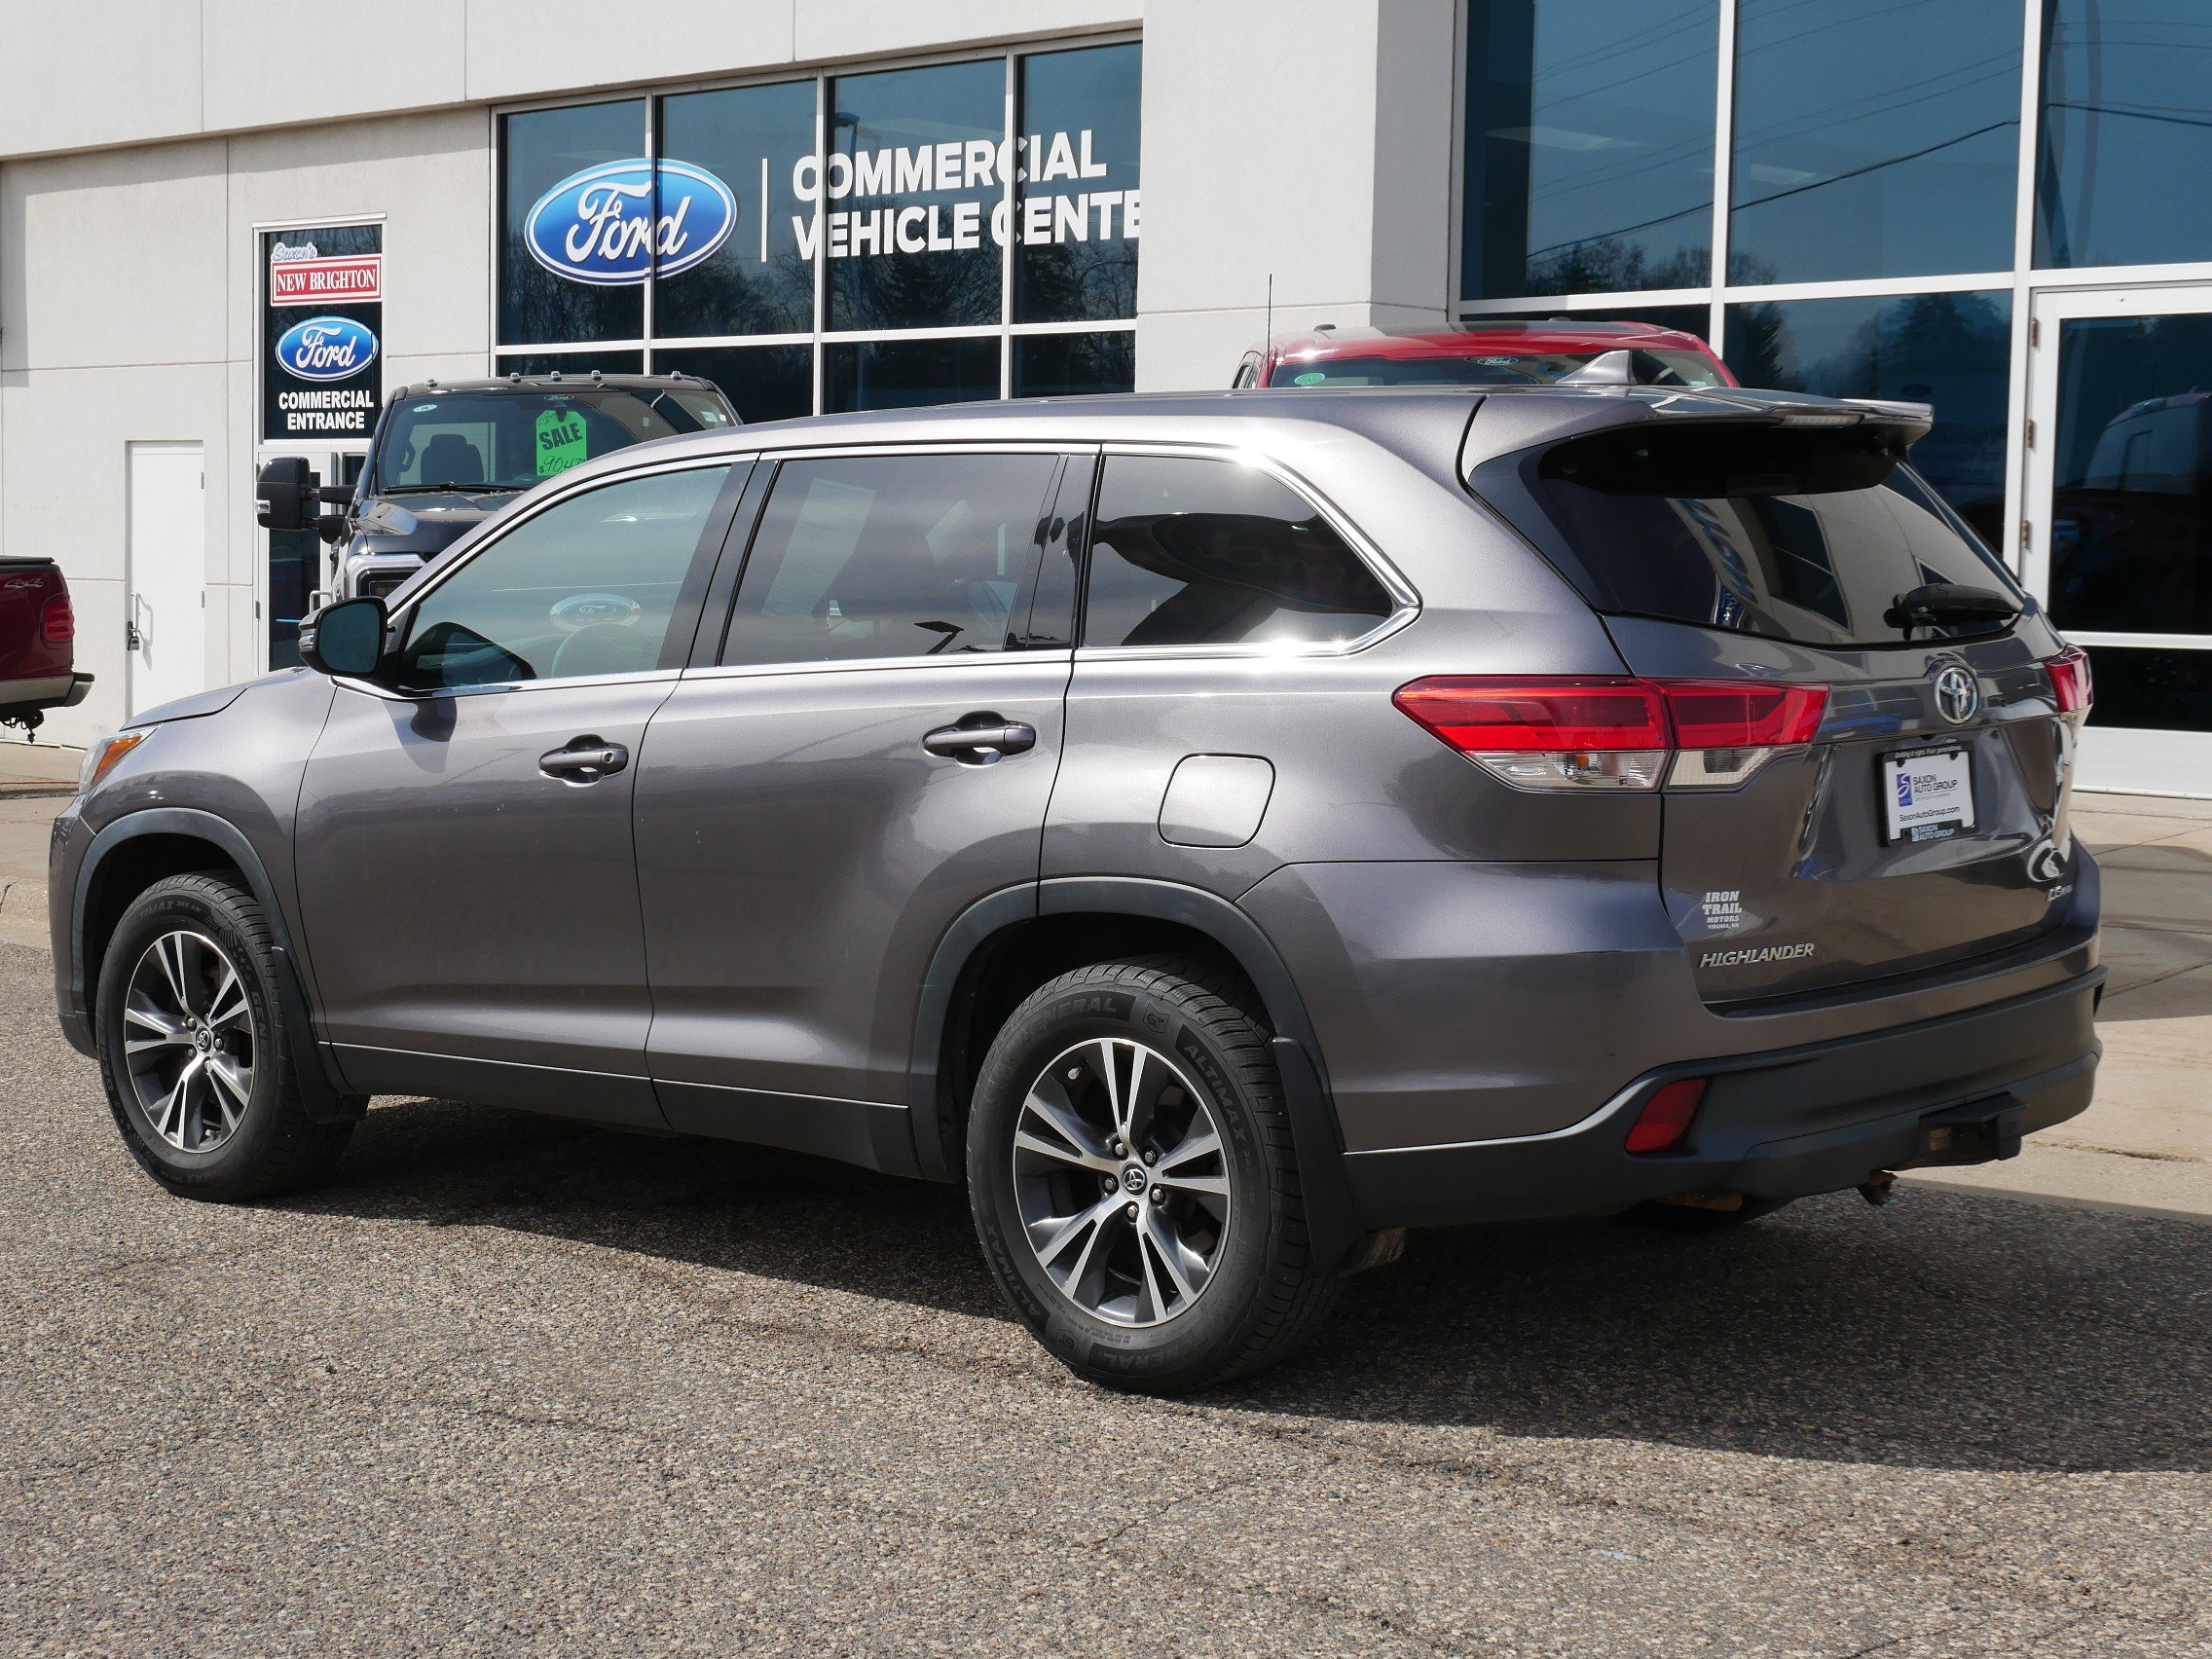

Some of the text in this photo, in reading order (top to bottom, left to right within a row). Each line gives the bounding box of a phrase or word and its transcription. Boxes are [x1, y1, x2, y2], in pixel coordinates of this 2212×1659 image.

[793, 129, 1107, 202] COMMERCIAL
[566, 181, 689, 262] Ford
[792, 203, 976, 262] VEHICLE
[272, 242, 317, 262] Saxon's
[277, 269, 376, 292] NEW BRIGHTON
[295, 325, 357, 369] Ford
[278, 390, 374, 409] COMMERCIAL
[287, 412, 365, 430] ENTRANCE
[538, 422, 583, 450] SALE
[1913, 774, 1936, 785] SAXON
[1914, 780, 1958, 793] AUTO GROUP
[1899, 806, 1960, 822] SaxonAutoGroup.com
[1918, 824, 1937, 833] SAXON
[1935, 828, 1955, 838] GROUP
[1705, 891, 1740, 903] IRON
[1702, 903, 1742, 915] TRAIL
[1699, 942, 1815, 968] HIGHLANDER
[1182, 1043, 1247, 1142] ALTIMAX
